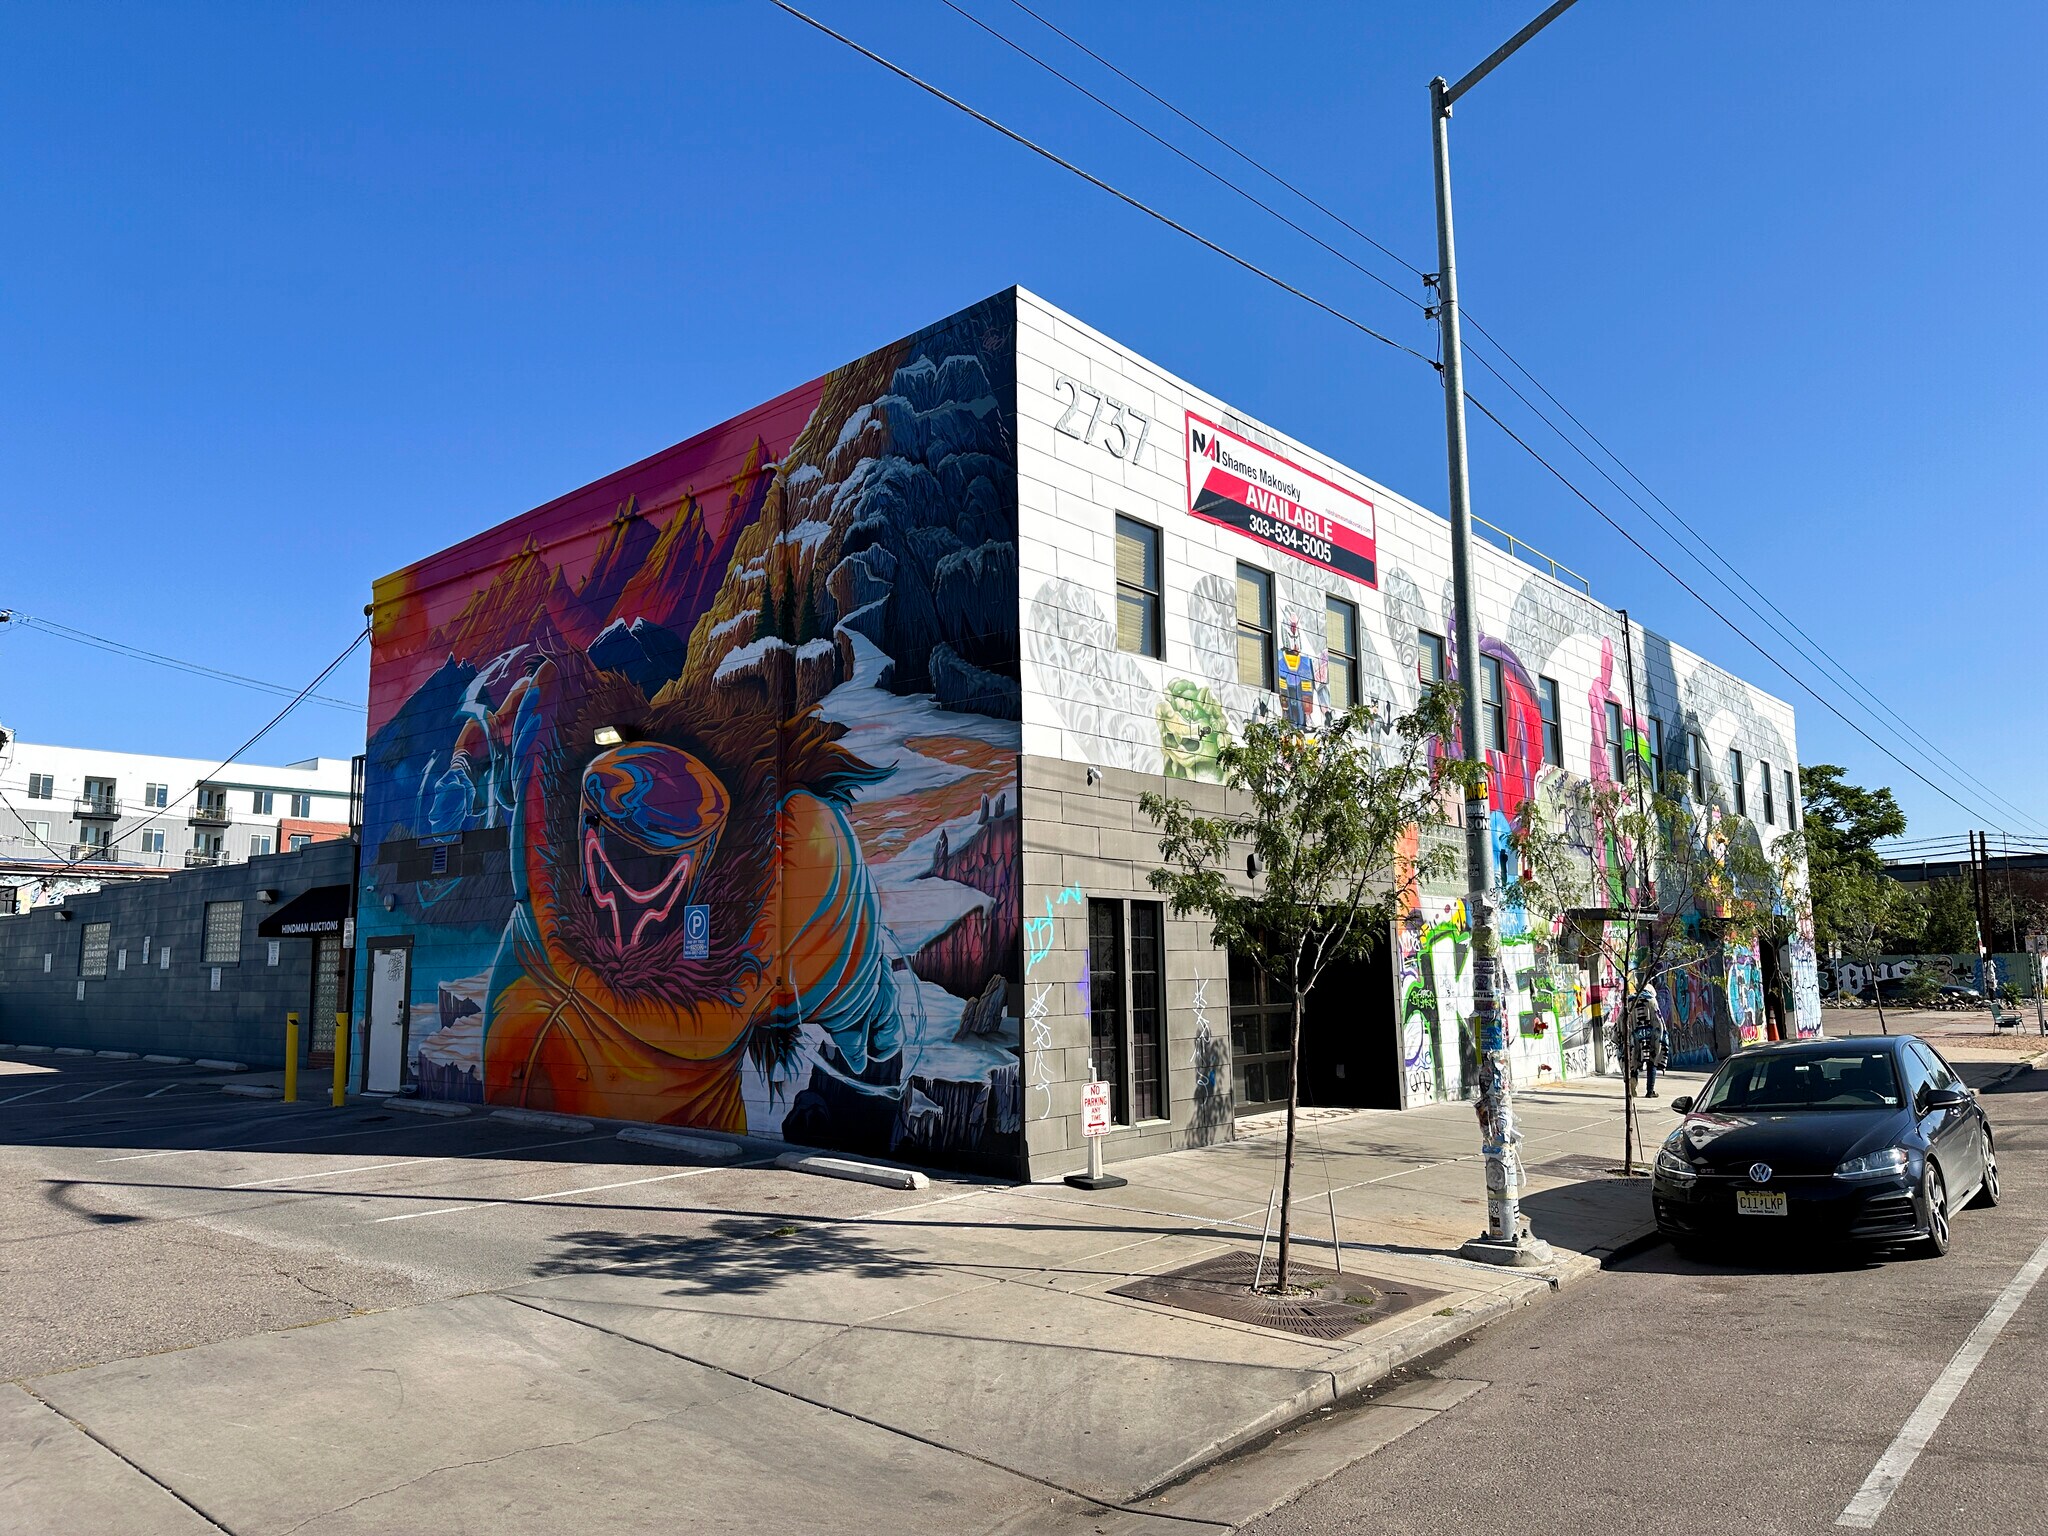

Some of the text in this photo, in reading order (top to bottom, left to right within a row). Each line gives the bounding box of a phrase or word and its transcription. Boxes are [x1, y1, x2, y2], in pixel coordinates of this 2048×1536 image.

[1054, 376, 1152, 465] 2737
[1192, 429, 1301, 502] NAI Shames Makovsky
[1246, 485, 1334, 541] AVAILABLE
[1249, 514, 1332, 562] 303-534-5005
[281, 920, 339, 934] HINDMAN AUCTIONS
[692, 915, 702, 934] P
[1084, 1096, 1108, 1107] PARKING
[1090, 1085, 1100, 1095] NO
